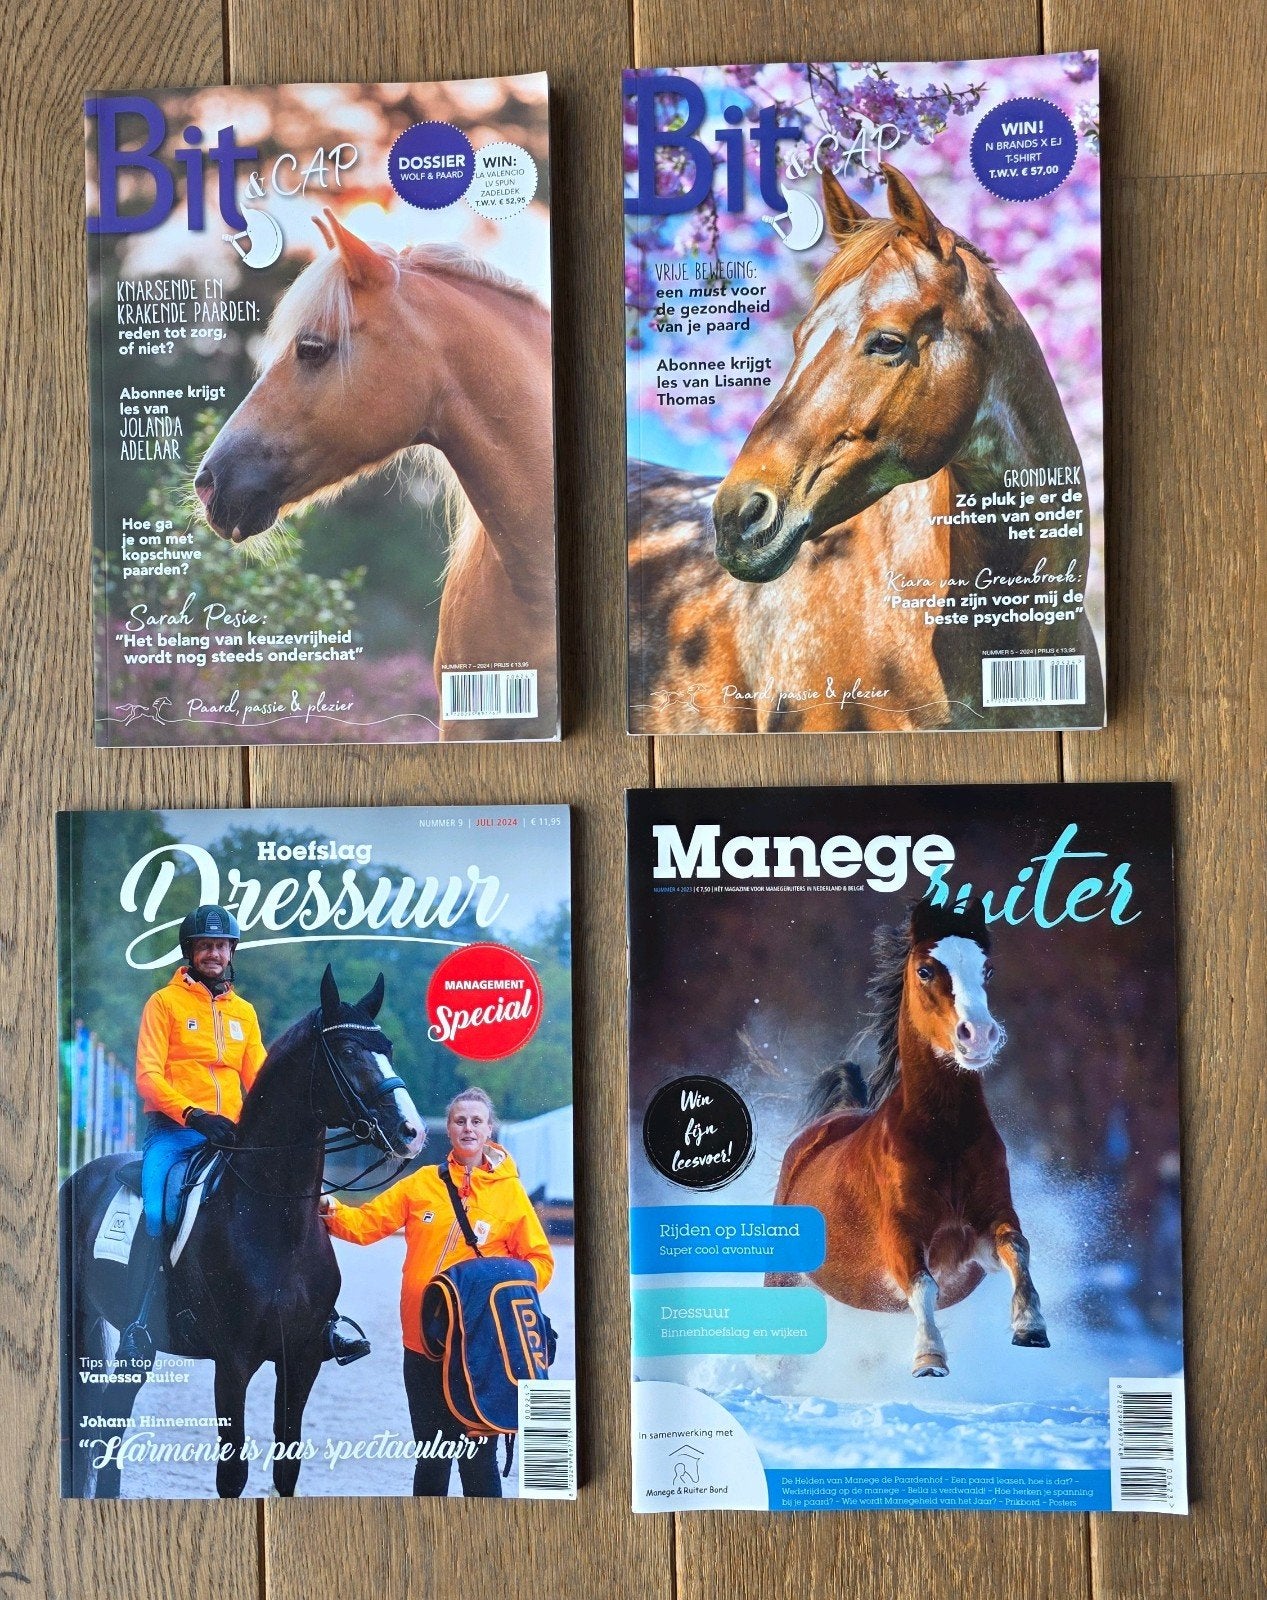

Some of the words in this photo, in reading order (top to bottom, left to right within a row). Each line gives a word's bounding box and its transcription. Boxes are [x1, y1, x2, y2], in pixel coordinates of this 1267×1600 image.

[1001, 120, 1044, 136] WIN!
[622, 75, 800, 216] Bit
[786, 160, 810, 181] &
[813, 123, 902, 178] CAP
[985, 142, 994, 152] N
[996, 139, 1038, 151] BRANDS
[1040, 139, 1049, 149] X
[1050, 137, 1062, 149] EJ
[85, 95, 258, 235] Bit
[398, 155, 466, 170] DOSSIER
[483, 156, 517, 168] WIN:
[1005, 152, 1042, 165] T-SHIRT
[243, 171, 267, 200] &
[271, 142, 359, 198] CAP
[400, 172, 425, 181] WOLF
[427, 172, 434, 180] &
[436, 170, 464, 180] PAARD
[486, 169, 525, 178] VALENCIO
[989, 168, 1019, 179] T.W.V.
[1021, 167, 1028, 177] €
[1030, 165, 1059, 176] 57,00
[495, 179, 515, 187] SPUN
[481, 188, 520, 197] ZADELDEK
[475, 199, 497, 207] T.W.V.
[506, 197, 526, 205] 52,95
[655, 263, 689, 281] VRIJE
[695, 261, 757, 280] BEWEGING:
[117, 279, 197, 301] KNARSENDE
[205, 278, 223, 298] EN
[656, 287, 683, 298] een
[689, 286, 727, 297] must
[731, 286, 766, 296] voor
[117, 303, 189, 325] KRAKENDE
[194, 302, 260, 322] PAARDEN:
[656, 303, 675, 316] de
[680, 300, 770, 318] gezondheid
[118, 326, 161, 341] reden
[164, 325, 187, 340] tot
[191, 327, 228, 343] zorg,
[656, 321, 683, 333] van
[687, 319, 701, 335] je
[706, 317, 750, 335] paard
[119, 341, 135, 355] of
[138, 340, 175, 355] niet?
[656, 358, 726, 372] Abonnee
[731, 357, 772, 373] krijgt
[657, 376, 678, 389] les
[683, 378, 709, 388] van
[715, 374, 772, 388] Lisanne
[120, 387, 184, 400] Abonnee
[187, 384, 226, 403] krijgt
[656, 393, 716, 406] Thomas
[120, 402, 140, 416] les
[143, 404, 169, 415] van
[120, 416, 183, 438] JOLANDA
[120, 439, 181, 461] ADELAAR
[1004, 466, 1081, 488] GRONDWERK
[955, 493, 977, 508] Zó
[982, 492, 1016, 510] pluk
[1019, 492, 1035, 509] je
[1039, 491, 1057, 501] er
[1062, 489, 1083, 503] de
[927, 511, 997, 526] vruchten
[1001, 511, 1029, 523] van
[1034, 507, 1084, 521] onder
[1008, 526, 1035, 540] het
[1039, 523, 1084, 538] zadel
[885, 570, 934, 592] Kiara
[940, 577, 969, 587] van
[975, 557, 1082, 590] Grevenbroek:
[960, 593, 987, 610] zijn
[992, 594, 1030, 606] voor
[1034, 591, 1058, 607] mij
[1063, 590, 1084, 603] de
[125, 593, 197, 632] Sarah
[203, 602, 268, 626] Pesie:
[925, 612, 969, 626] beste
[157, 632, 211, 650] belang
[214, 634, 243, 647] van
[247, 631, 353, 649] keuzevrijheid
[124, 650, 173, 665] wordt
[176, 652, 206, 667] nog
[211, 648, 265, 664] steeds
[187, 690, 239, 717] Paard,
[242, 697, 286, 724] passie
[290, 690, 302, 711] &
[307, 691, 354, 723] plezier
[419, 819, 456, 828] NUMMER
[458, 818, 464, 828] 9
[476, 818, 494, 827] JULI
[496, 817, 518, 827] 2024
[531, 817, 537, 826] €
[539, 817, 561, 827] 11,95
[257, 840, 373, 865] Hoefslag
[653, 824, 956, 893] Manege
[119, 843, 511, 970] Dressuur
[444, 979, 525, 992] MANAGEMENT
[427, 988, 533, 1043] Special
[680, 1090, 713, 1112] Win
[684, 1118, 717, 1146] fijn
[672, 1141, 732, 1172] leesvoer!
[660, 1224, 711, 1240] Rijden
[715, 1226, 737, 1240] op
[740, 1223, 800, 1237] IJsland
[659, 1245, 693, 1257] Super
[695, 1244, 719, 1255] cool
[721, 1246, 774, 1255] avontuur
[660, 1306, 730, 1320] Dressuur
[661, 1328, 750, 1340] Binnenhoefslag
[753, 1329, 768, 1338] en
[771, 1328, 808, 1339] wijken
[79, 1357, 103, 1369] Tips
[106, 1359, 127, 1368] van
[131, 1358, 152, 1370] top
[155, 1358, 195, 1370] groom
[79, 1372, 142, 1384] Vanessa
[145, 1372, 190, 1384] Ruiter
[79, 1416, 136, 1428] Johann
[139, 1416, 232, 1428] Hinnemann:
[639, 1432, 647, 1440] In
[650, 1429, 713, 1439] samenwerking
[715, 1429, 733, 1437] met
[239, 1436, 264, 1461] is
[262, 1437, 319, 1472] pas
[782, 1477, 793, 1485] De
[795, 1477, 824, 1485] Helden
[845, 1477, 879, 1486] Manege
[882, 1476, 892, 1484] de
[894, 1476, 943, 1484] Paardenhof
[969, 1477, 994, 1486] paard
[1055, 1477, 1073, 1485] dat?
[645, 1488, 675, 1498] Manege
[676, 1487, 682, 1495] &
[683, 1486, 707, 1495] Ruiter
[709, 1485, 728, 1494] Bond
